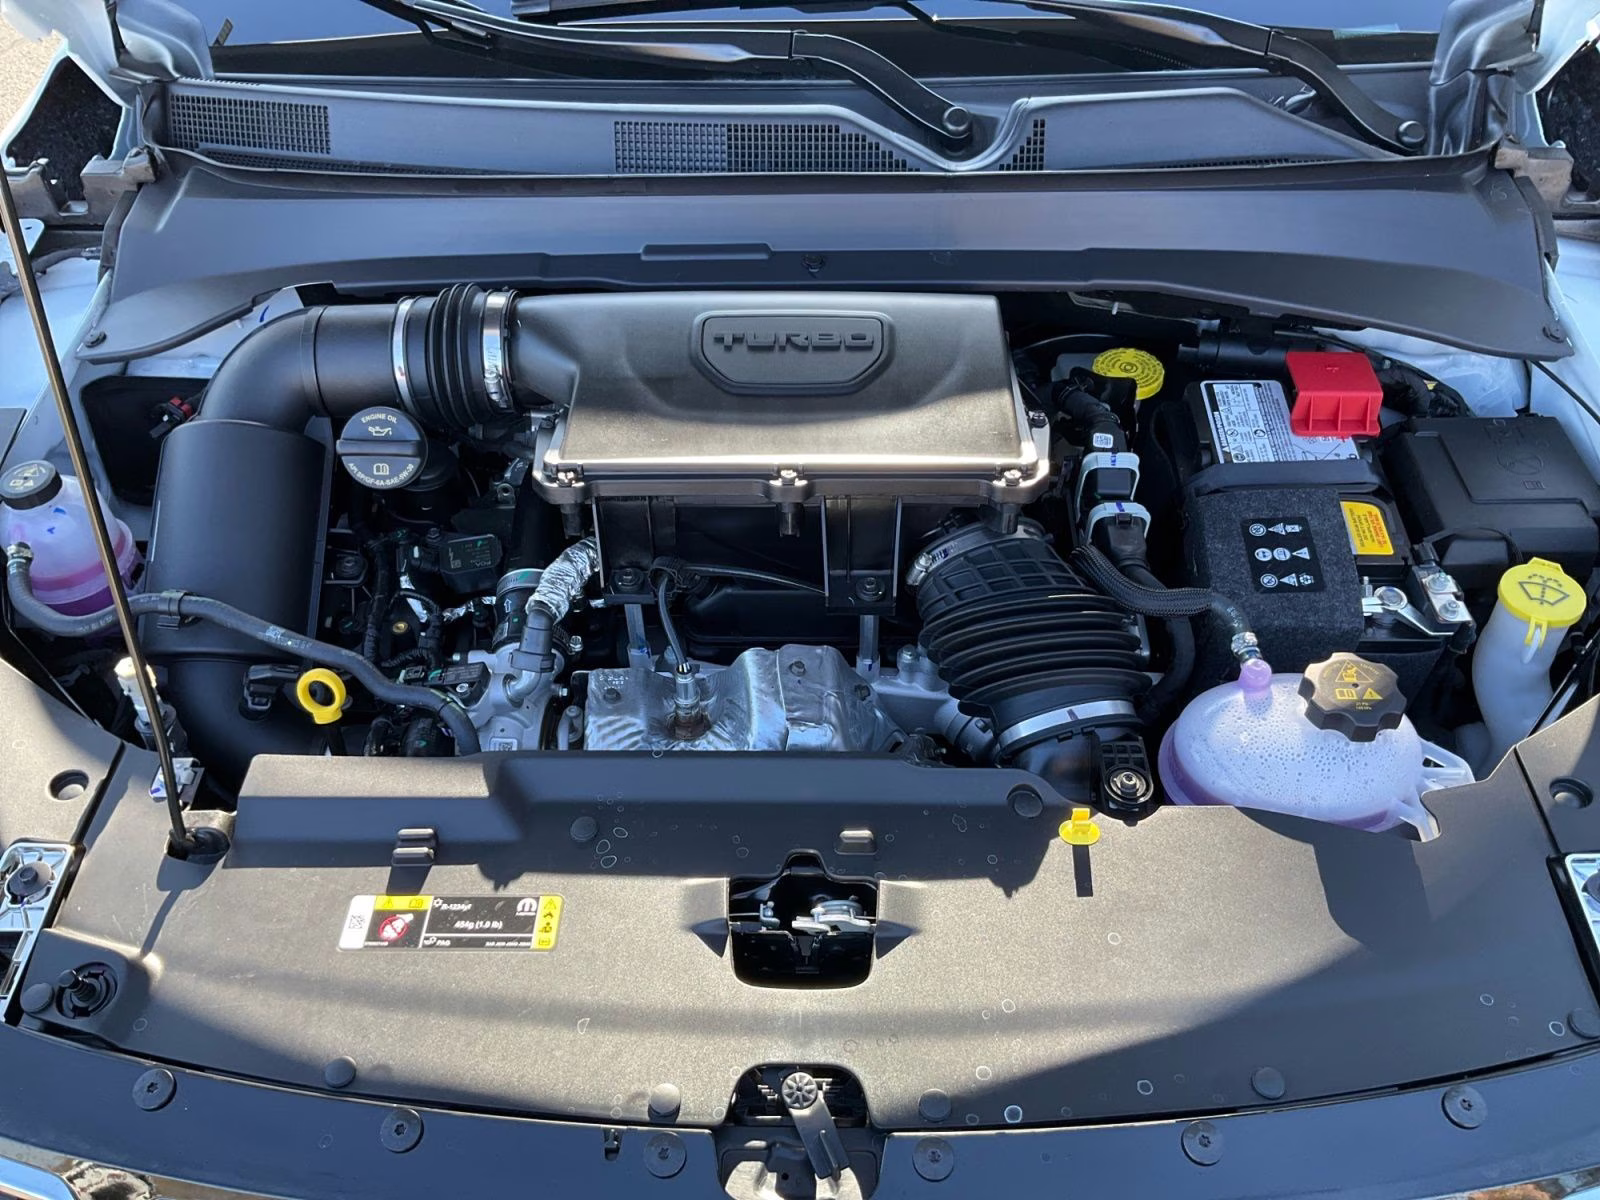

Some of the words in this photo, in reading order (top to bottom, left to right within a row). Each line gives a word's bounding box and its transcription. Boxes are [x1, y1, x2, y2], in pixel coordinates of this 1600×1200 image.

[713, 330, 875, 352] TURBO
[361, 413, 387, 424] ENGINE
[387, 414, 398, 424] OIL
[454, 920, 475, 930] 454g
